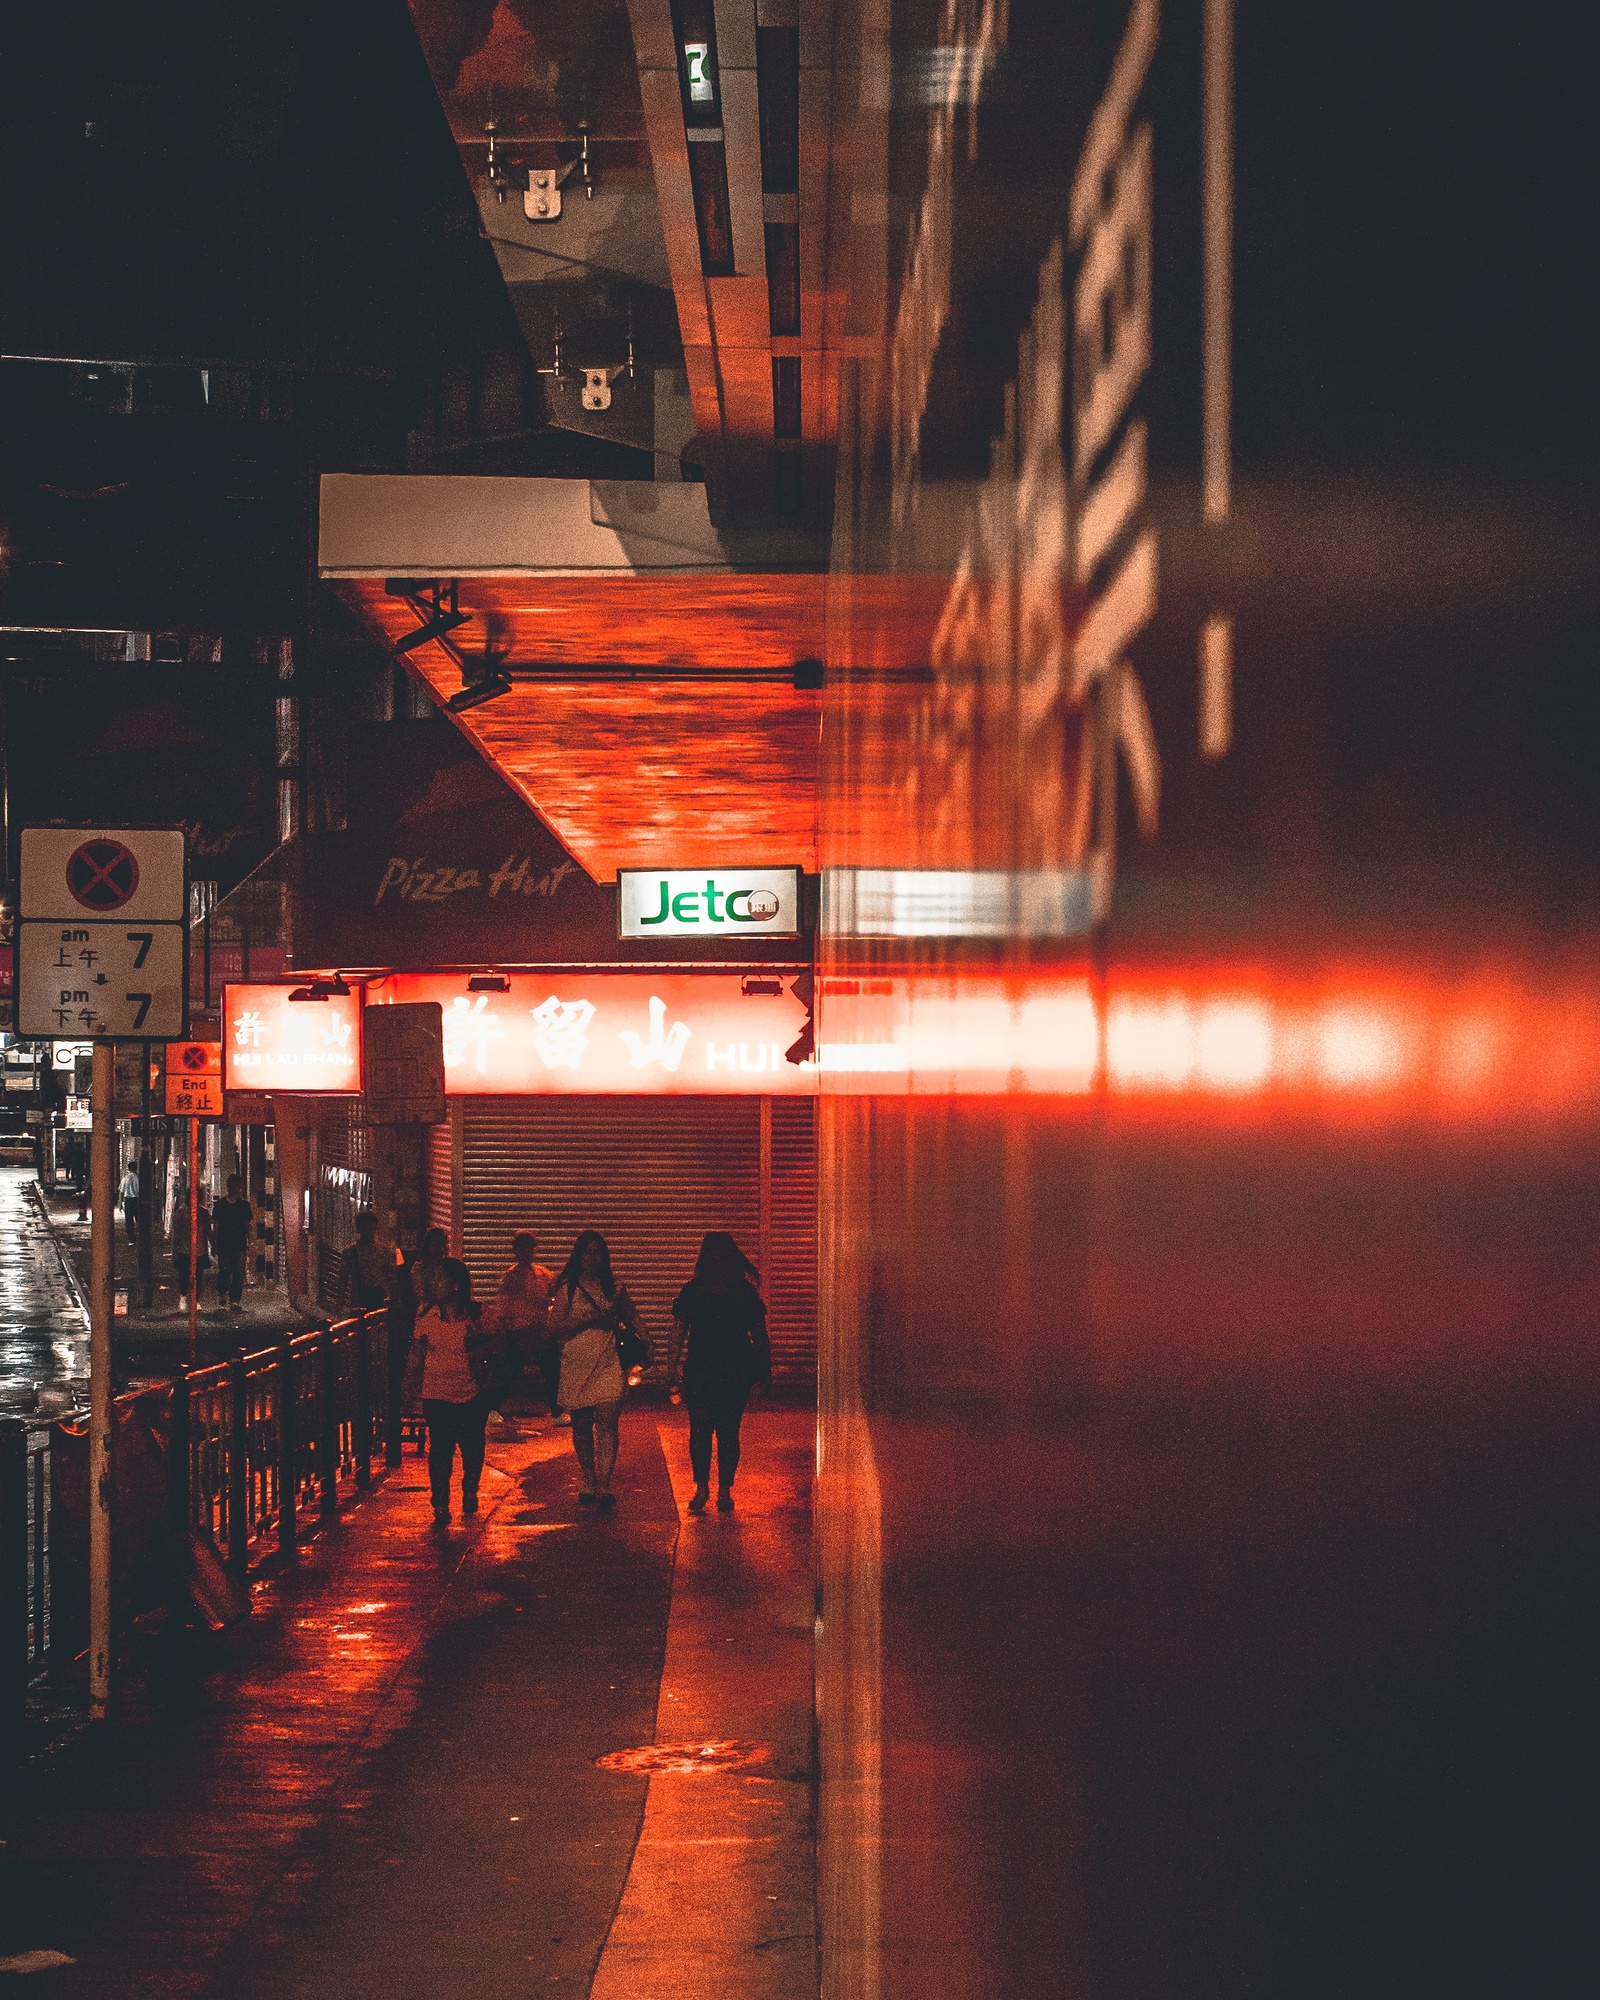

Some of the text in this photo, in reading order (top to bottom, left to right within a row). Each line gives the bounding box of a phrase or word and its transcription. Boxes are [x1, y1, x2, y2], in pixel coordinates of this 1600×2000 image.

[375, 854, 582, 905] Pizza Hut
[61, 928, 90, 942] am
[52, 947, 99, 968] 上午
[126, 933, 153, 969] 7
[60, 989, 90, 1005] pm
[52, 1008, 98, 1029] 下午
[126, 993, 153, 1029] 7
[233, 1011, 351, 1047] 許山
[442, 995, 692, 1073] 許留山
[233, 1053, 262, 1067] HUI
[265, 1053, 298, 1066] LAU
[706, 1043, 780, 1072] HUI
[182, 1079, 207, 1091] End
[176, 1094, 213, 1111] 終止
